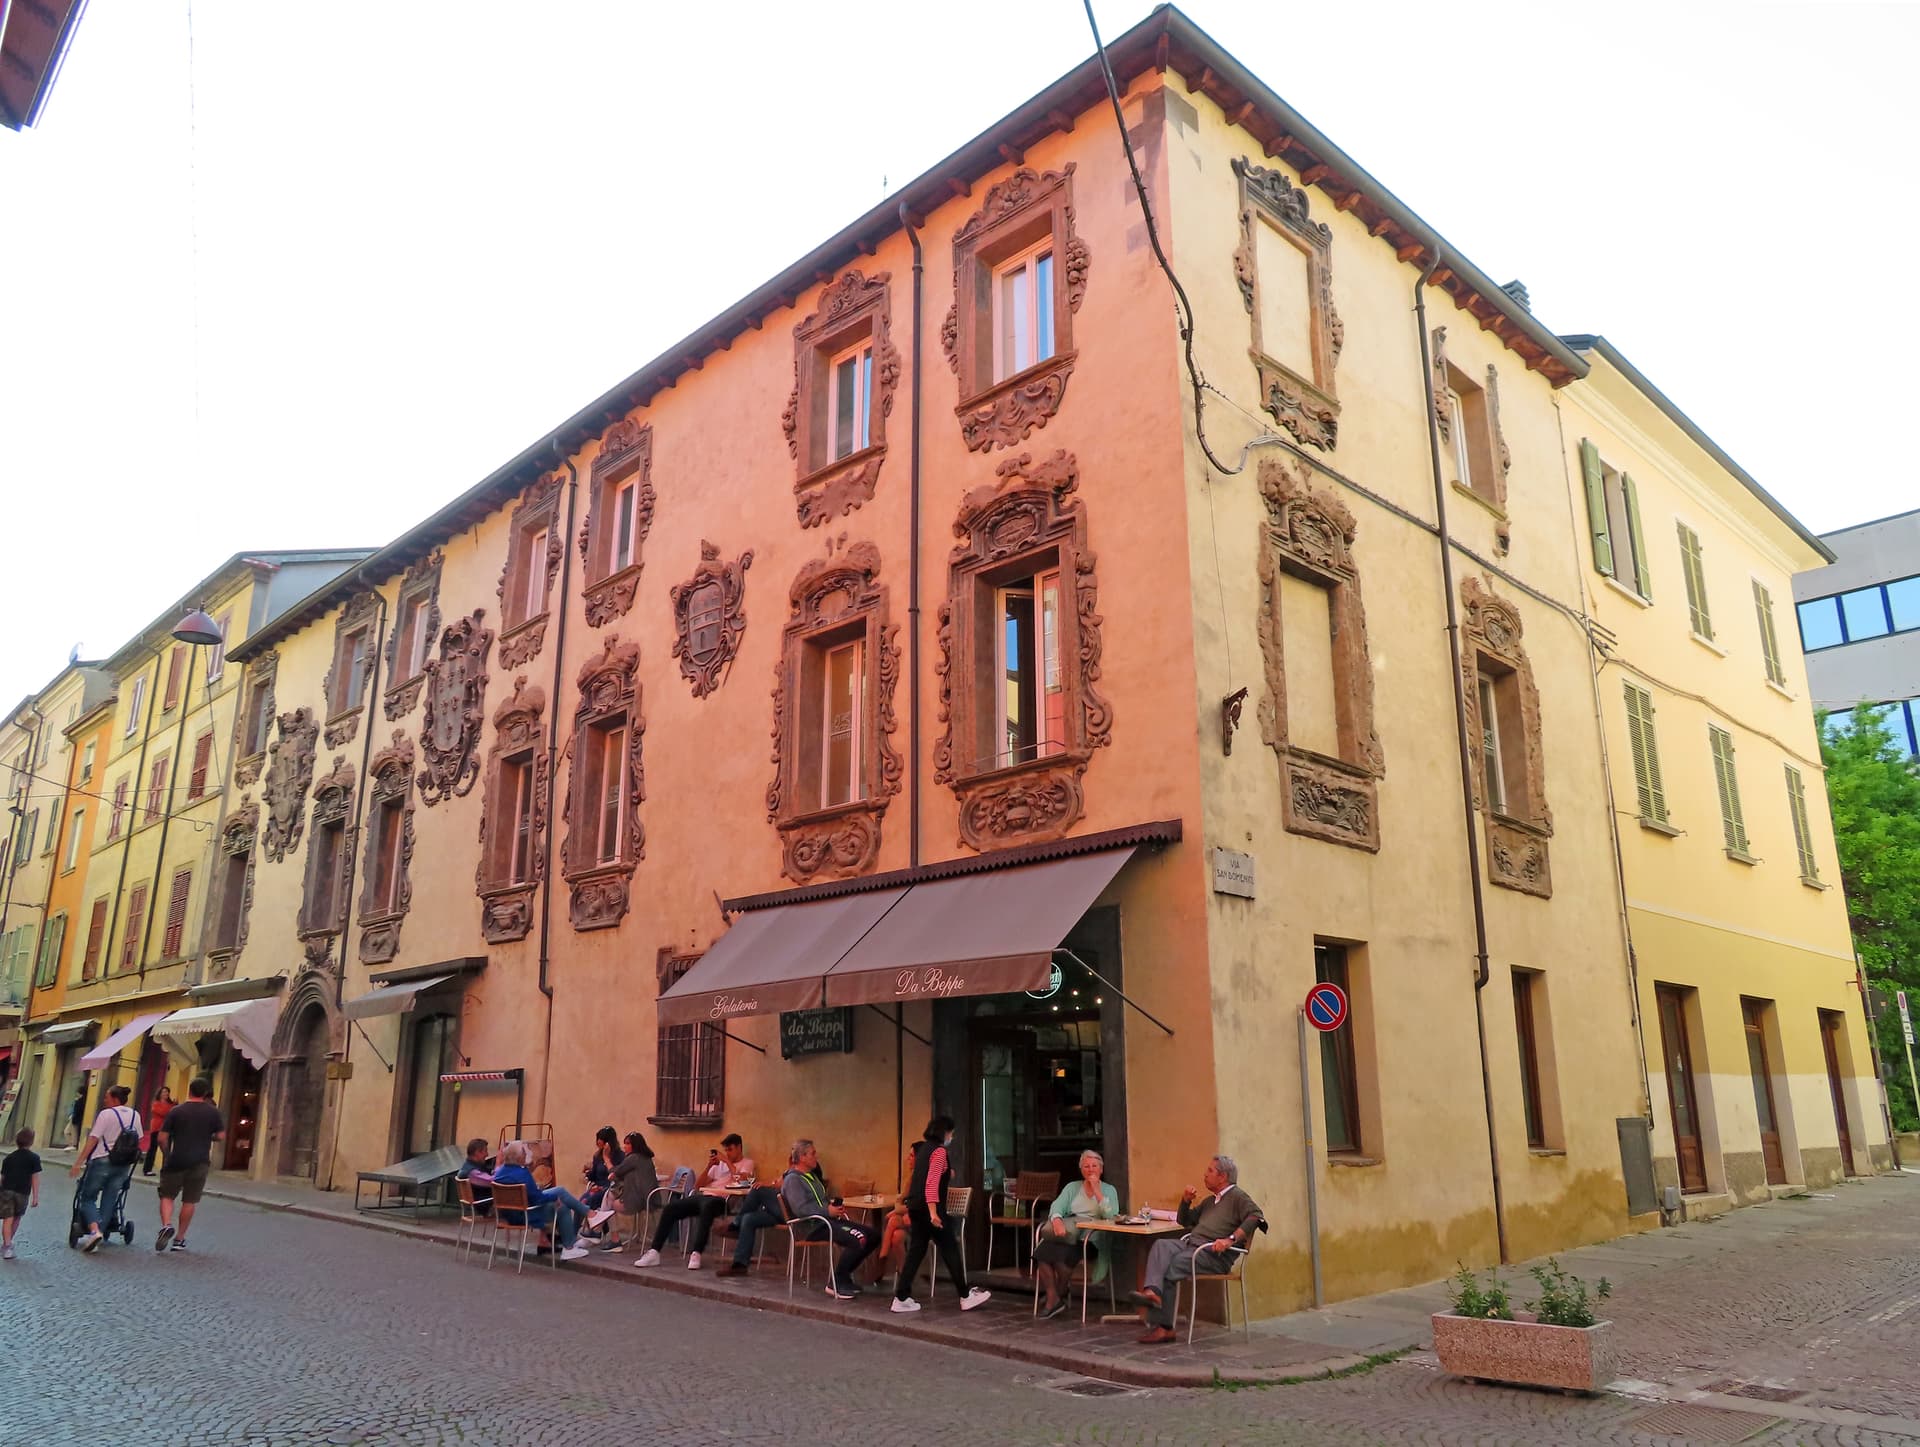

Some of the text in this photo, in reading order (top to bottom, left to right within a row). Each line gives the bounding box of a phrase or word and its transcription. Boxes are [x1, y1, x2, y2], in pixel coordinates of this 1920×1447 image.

[1230, 859, 1240, 869] VIA
[895, 967, 965, 997] Da Beppe
[710, 995, 758, 1019] Gelateria
[788, 1019, 804, 1036] da
